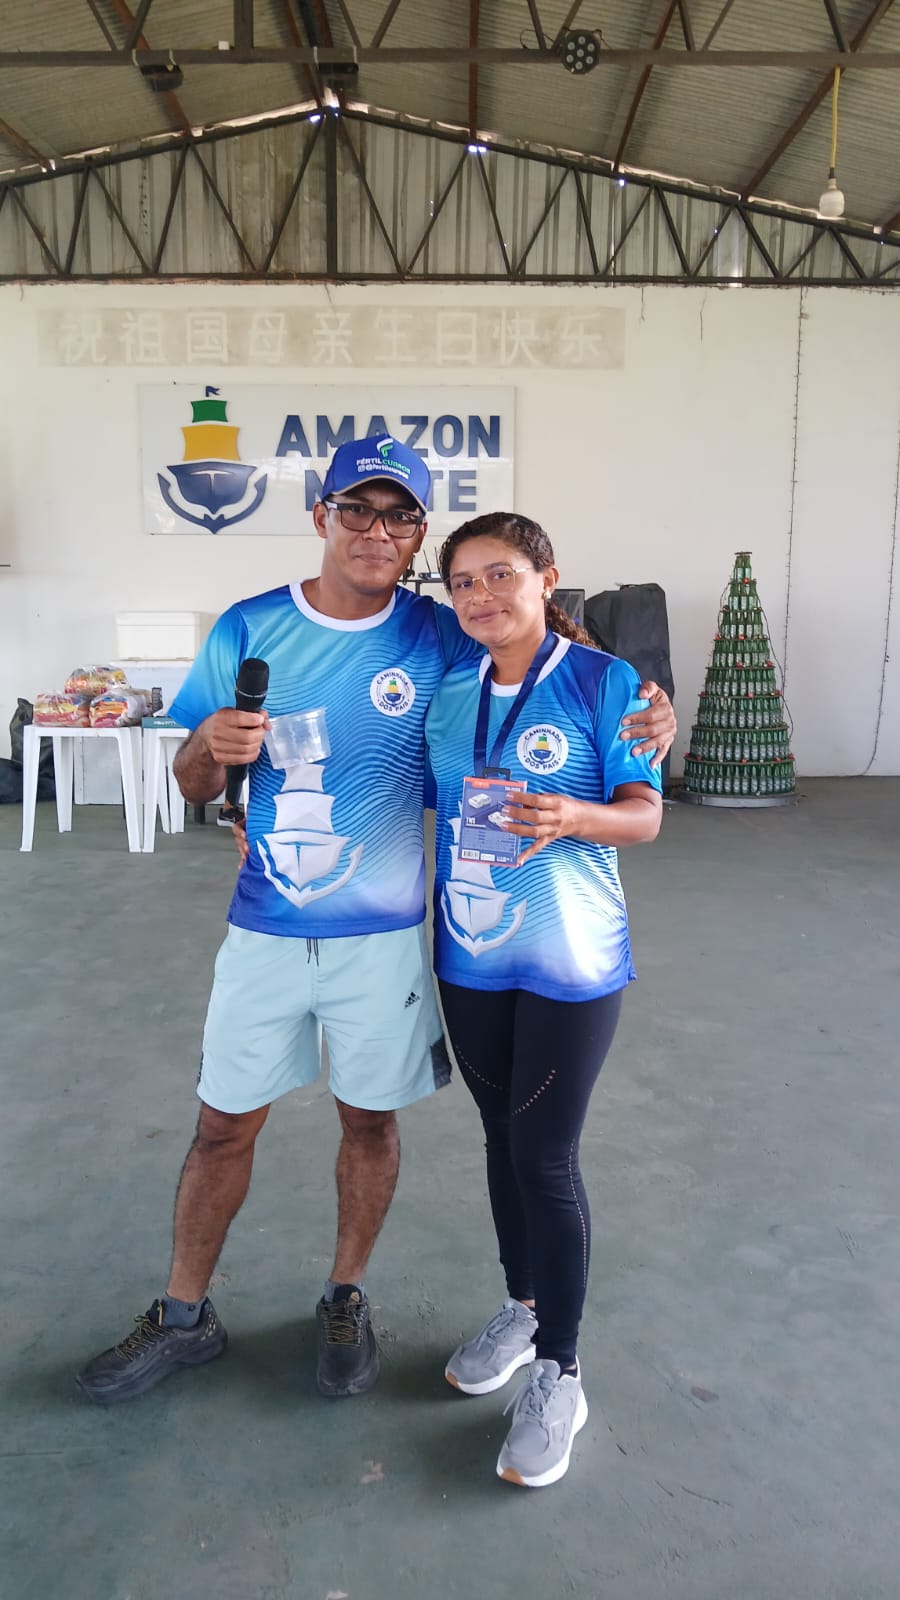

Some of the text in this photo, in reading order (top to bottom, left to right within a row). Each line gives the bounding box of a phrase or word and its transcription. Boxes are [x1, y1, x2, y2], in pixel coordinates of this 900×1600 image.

[58, 308, 604, 366] 祝祖国母亲生日快乐
[376, 672, 408, 686] CAMINHADA
[395, 701, 408, 712] PAIS
[524, 728, 562, 743] CAMINHADA
[525, 757, 559, 769] DOS PAIS
